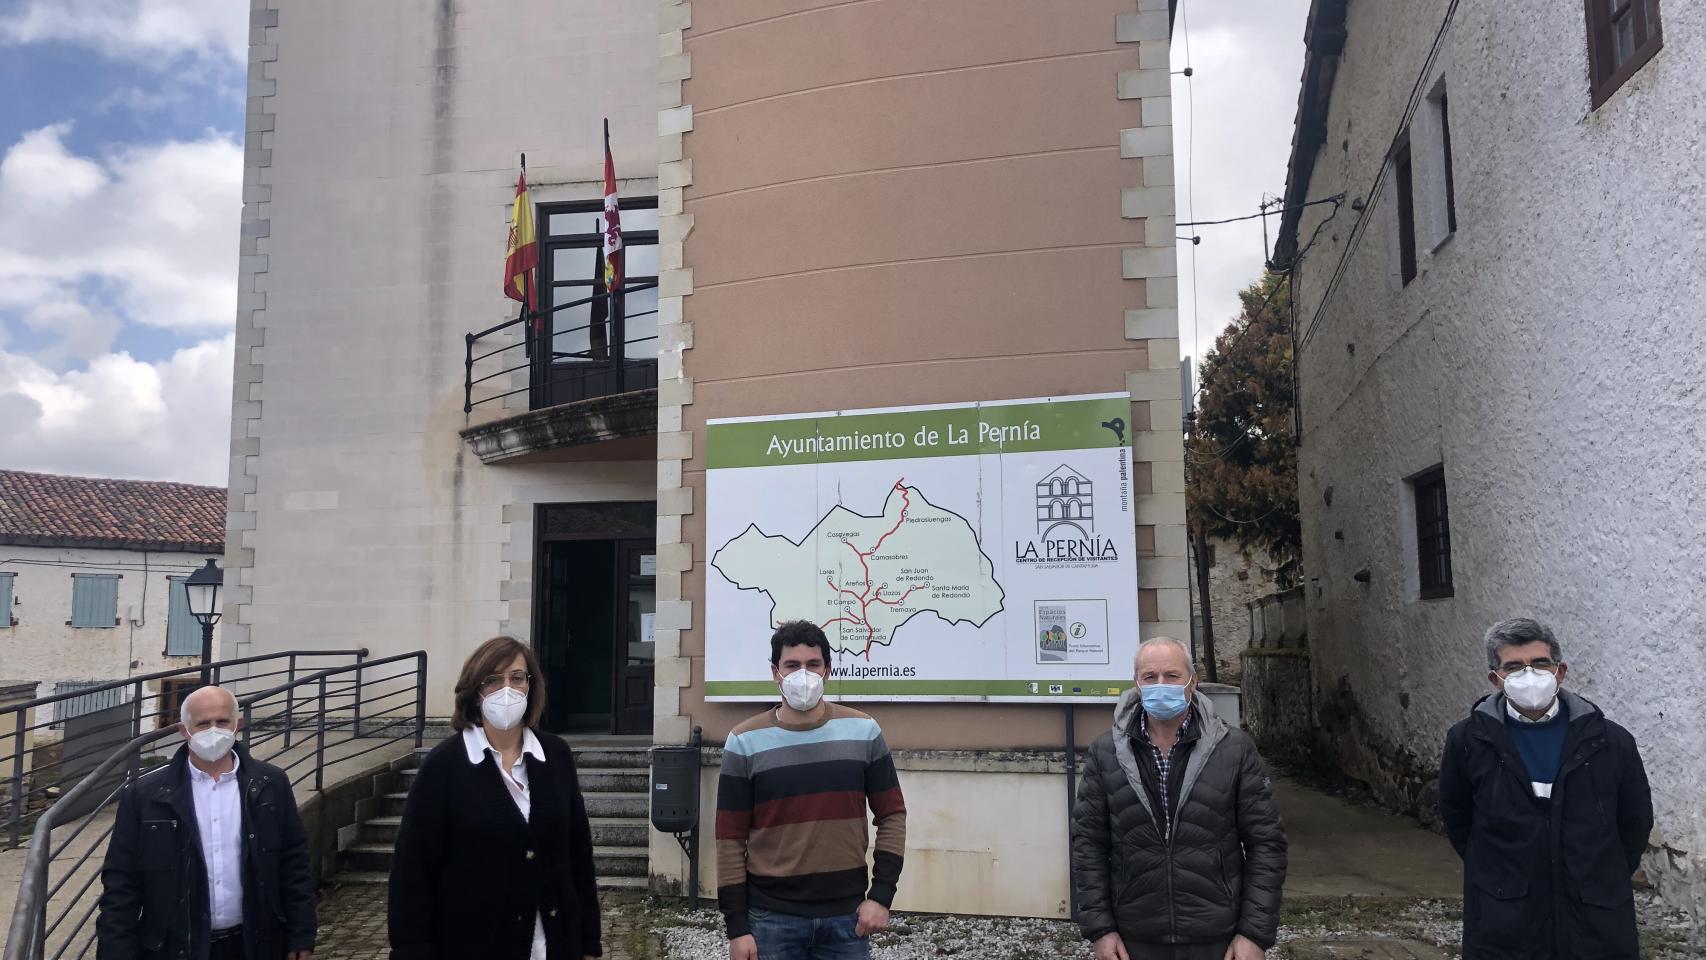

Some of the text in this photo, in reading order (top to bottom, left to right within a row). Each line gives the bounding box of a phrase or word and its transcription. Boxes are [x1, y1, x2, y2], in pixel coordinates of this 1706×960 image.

[766, 420, 1041, 458] Ayuntamiento de La Pernía
[1119, 448, 1128, 512] montaña palentina
[906, 516, 951, 524] Piedrasluengas
[1015, 534, 1118, 559] LA PERNÍA
[845, 579, 866, 587] Areños
[890, 606, 917, 614] Tremaya
[830, 663, 916, 679] ww.lapernia.es
